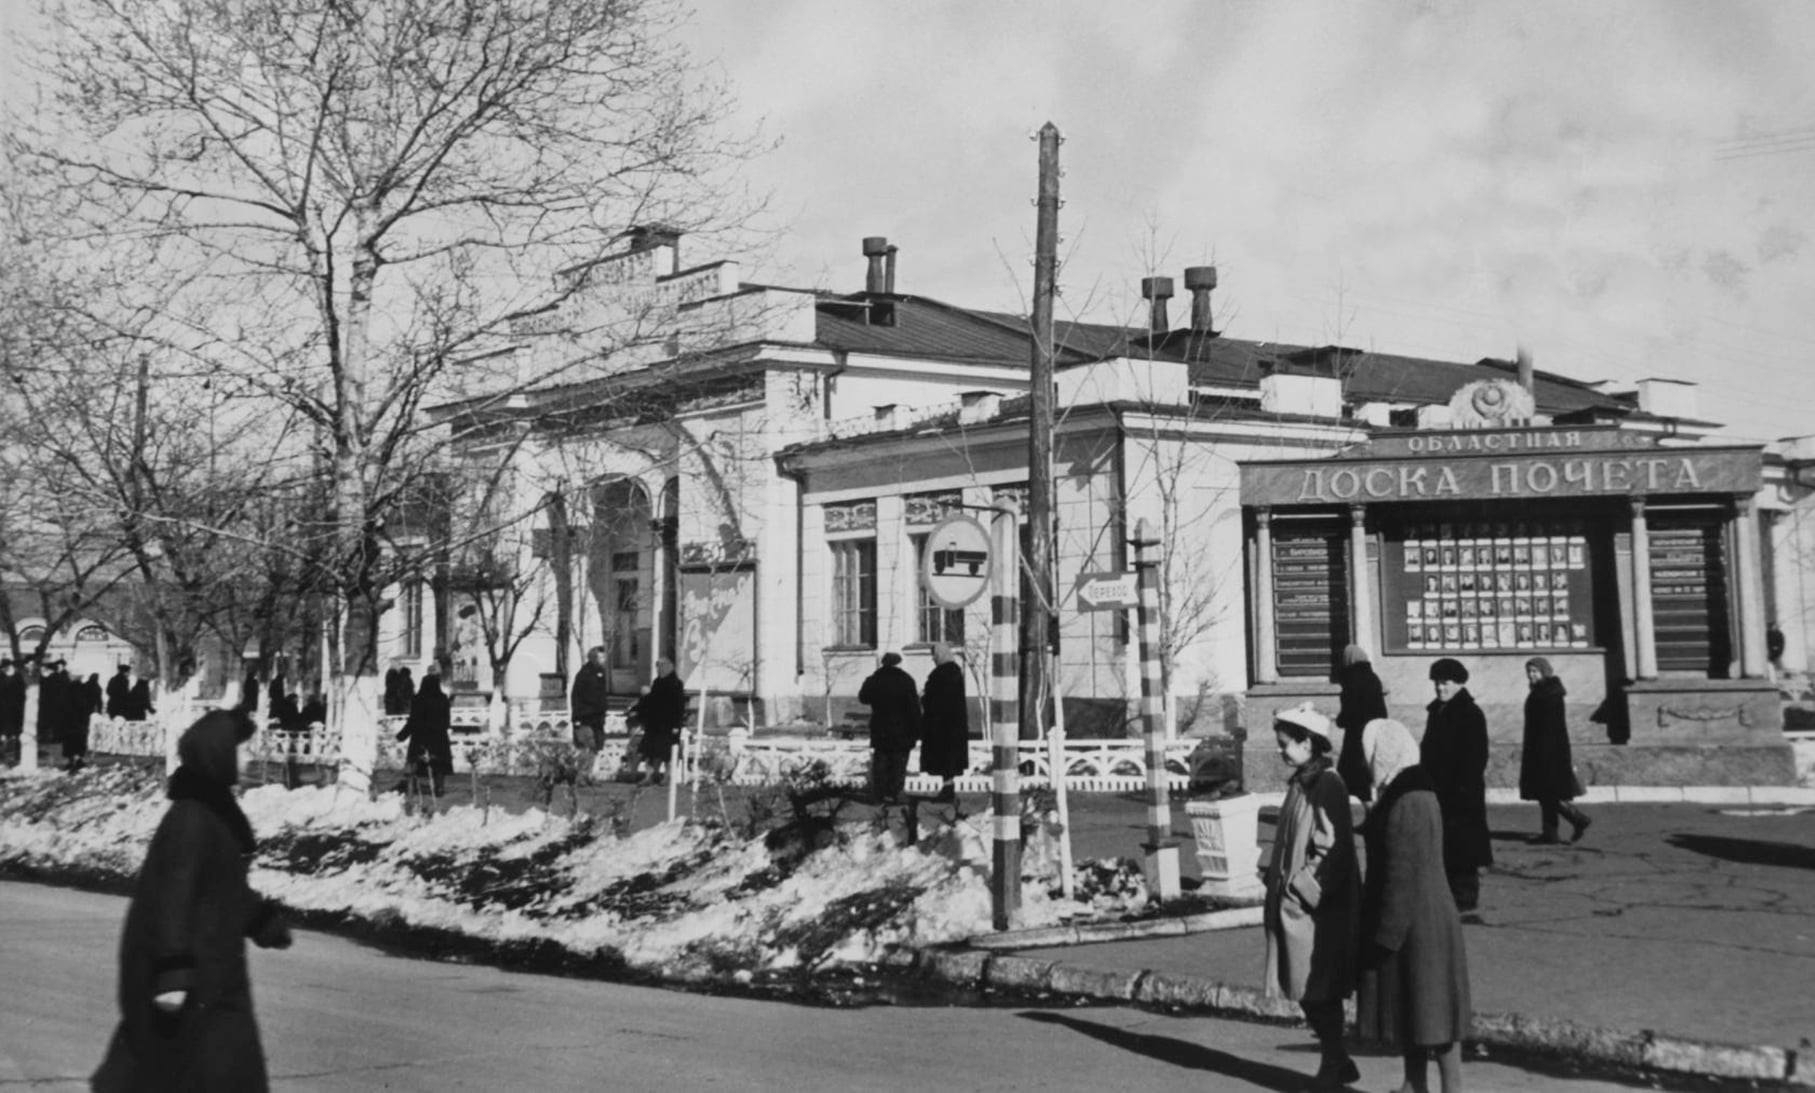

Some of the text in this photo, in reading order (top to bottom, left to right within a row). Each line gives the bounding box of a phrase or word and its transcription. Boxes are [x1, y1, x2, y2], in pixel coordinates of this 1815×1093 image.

[1408, 431, 1582, 452] ОБЛАСТНАЯ
[1298, 457, 1705, 502] ДОСКА ПОЧЕТА
